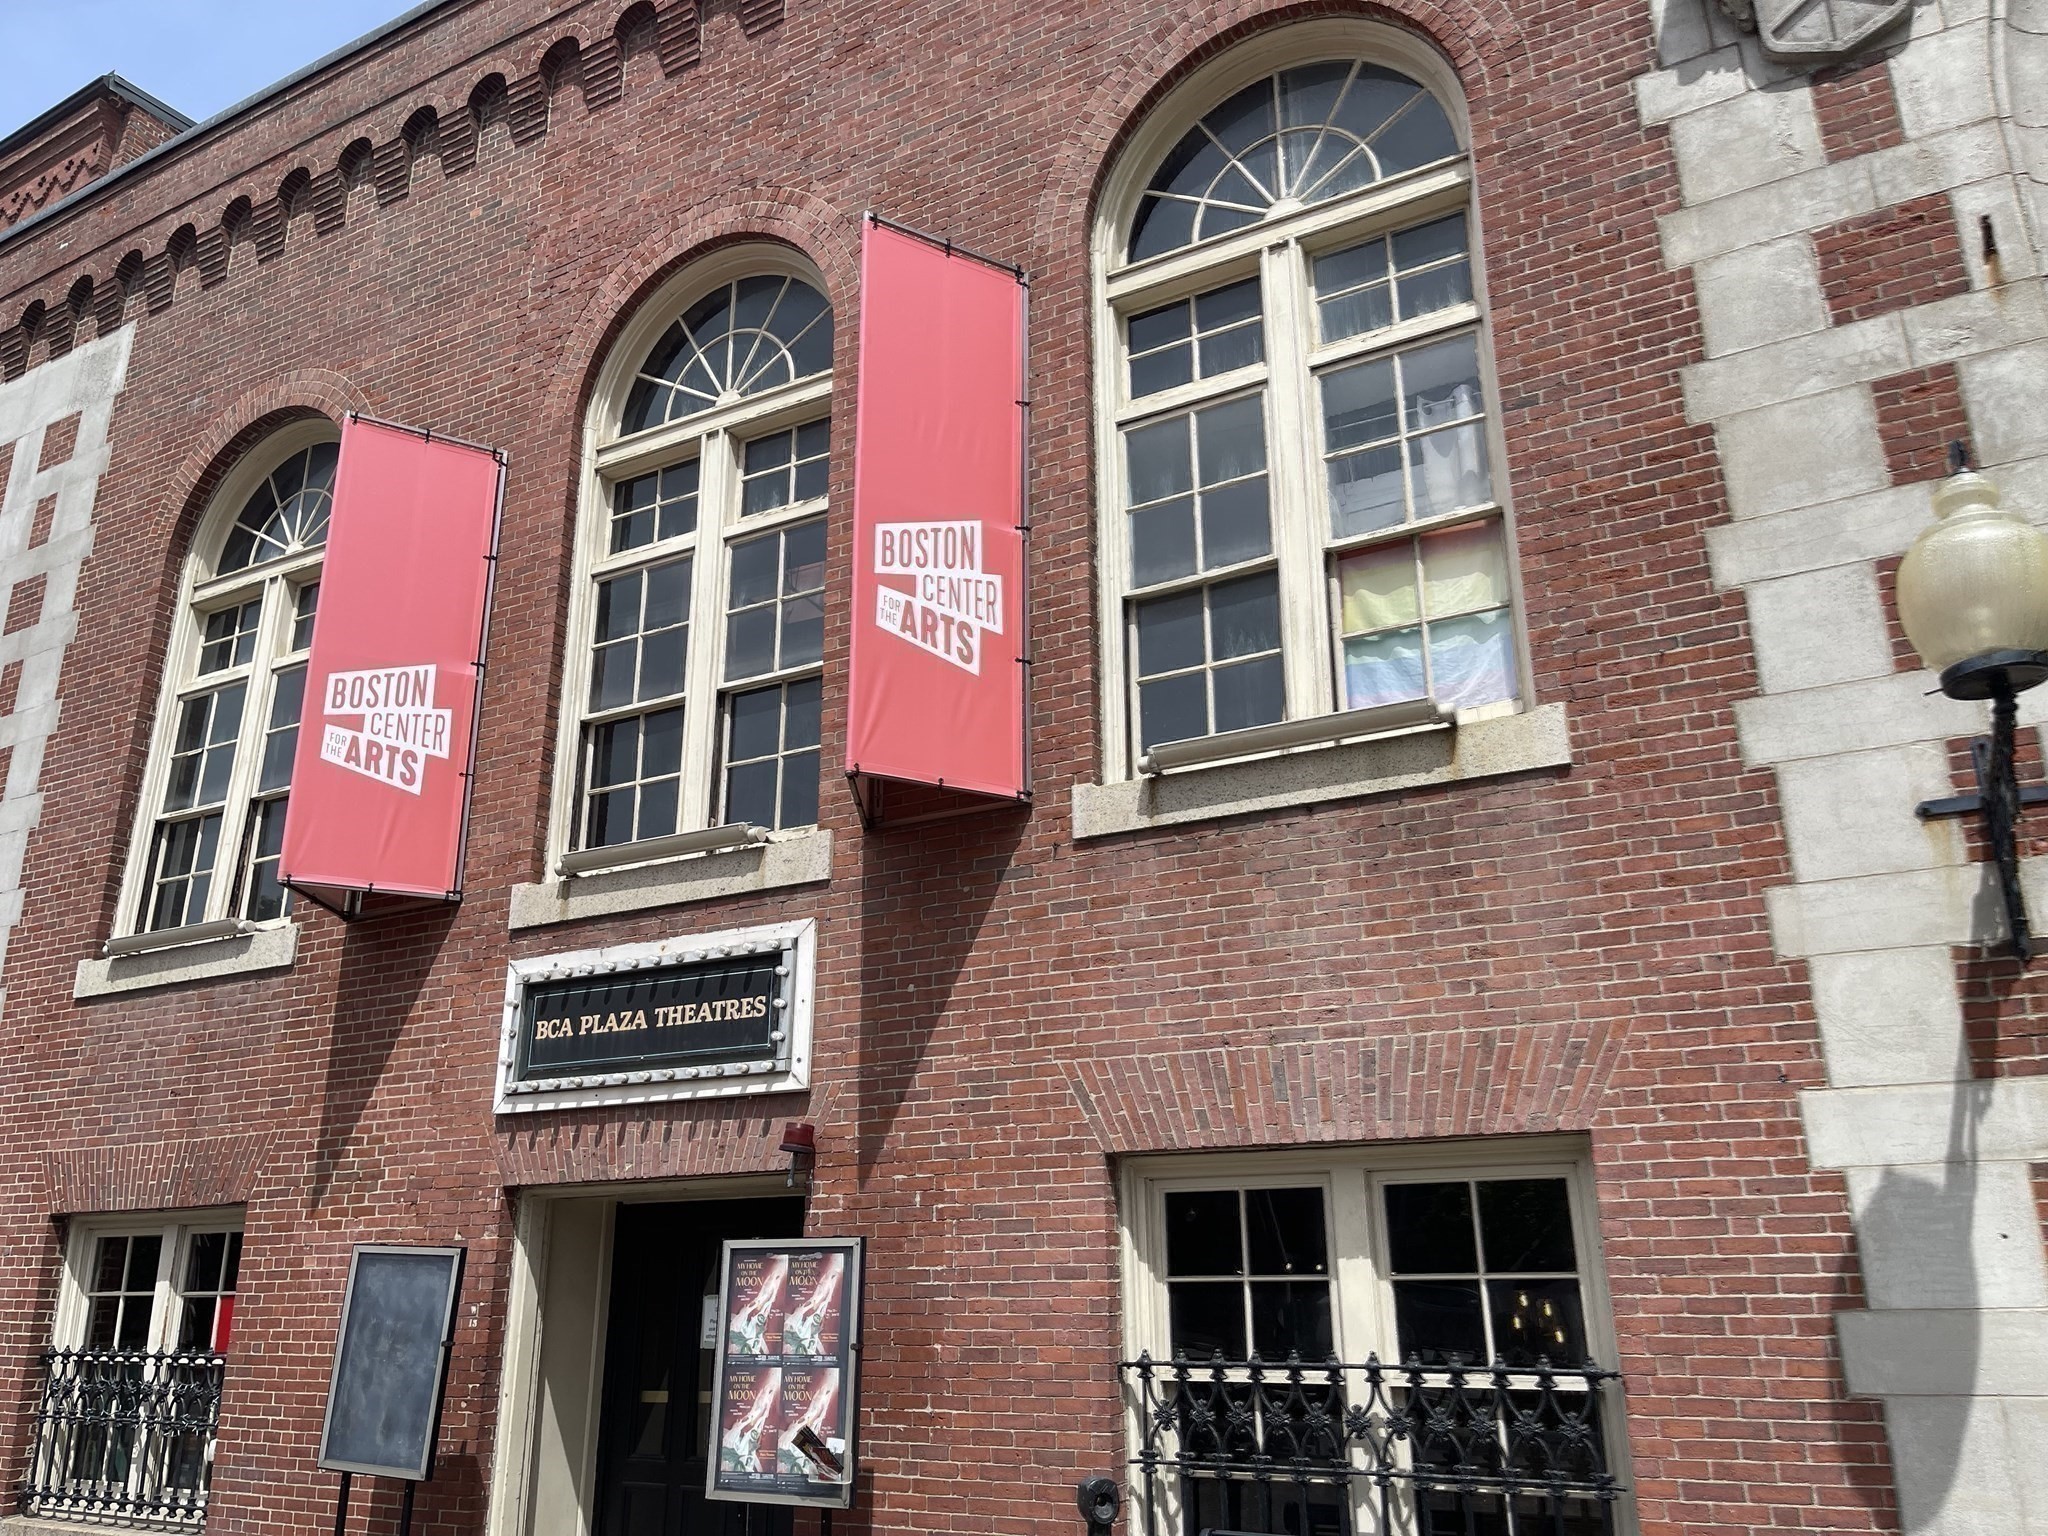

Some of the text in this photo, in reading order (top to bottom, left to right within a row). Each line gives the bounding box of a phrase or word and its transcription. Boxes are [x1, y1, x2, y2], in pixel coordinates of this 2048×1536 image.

[881, 526, 975, 571] BOSTON
[883, 595, 901, 612] FOR
[922, 574, 997, 626] CENTER
[880, 607, 897, 626] THE
[899, 600, 974, 665] ARTS
[331, 669, 429, 709] BOSTON
[329, 732, 347, 747] FOR
[370, 712, 446, 752] CENTER
[325, 743, 342, 758] THE
[343, 735, 418, 787] ARTS
[535, 995, 767, 1040] BCA PLAZA THEATRES
[736, 1276, 764, 1287] MOON
[790, 1275, 819, 1286] MOON
[739, 1375, 757, 1383] HOME
[794, 1375, 813, 1383] HOME
[728, 1389, 757, 1401] MOON
[783, 1390, 814, 1401] MOON
